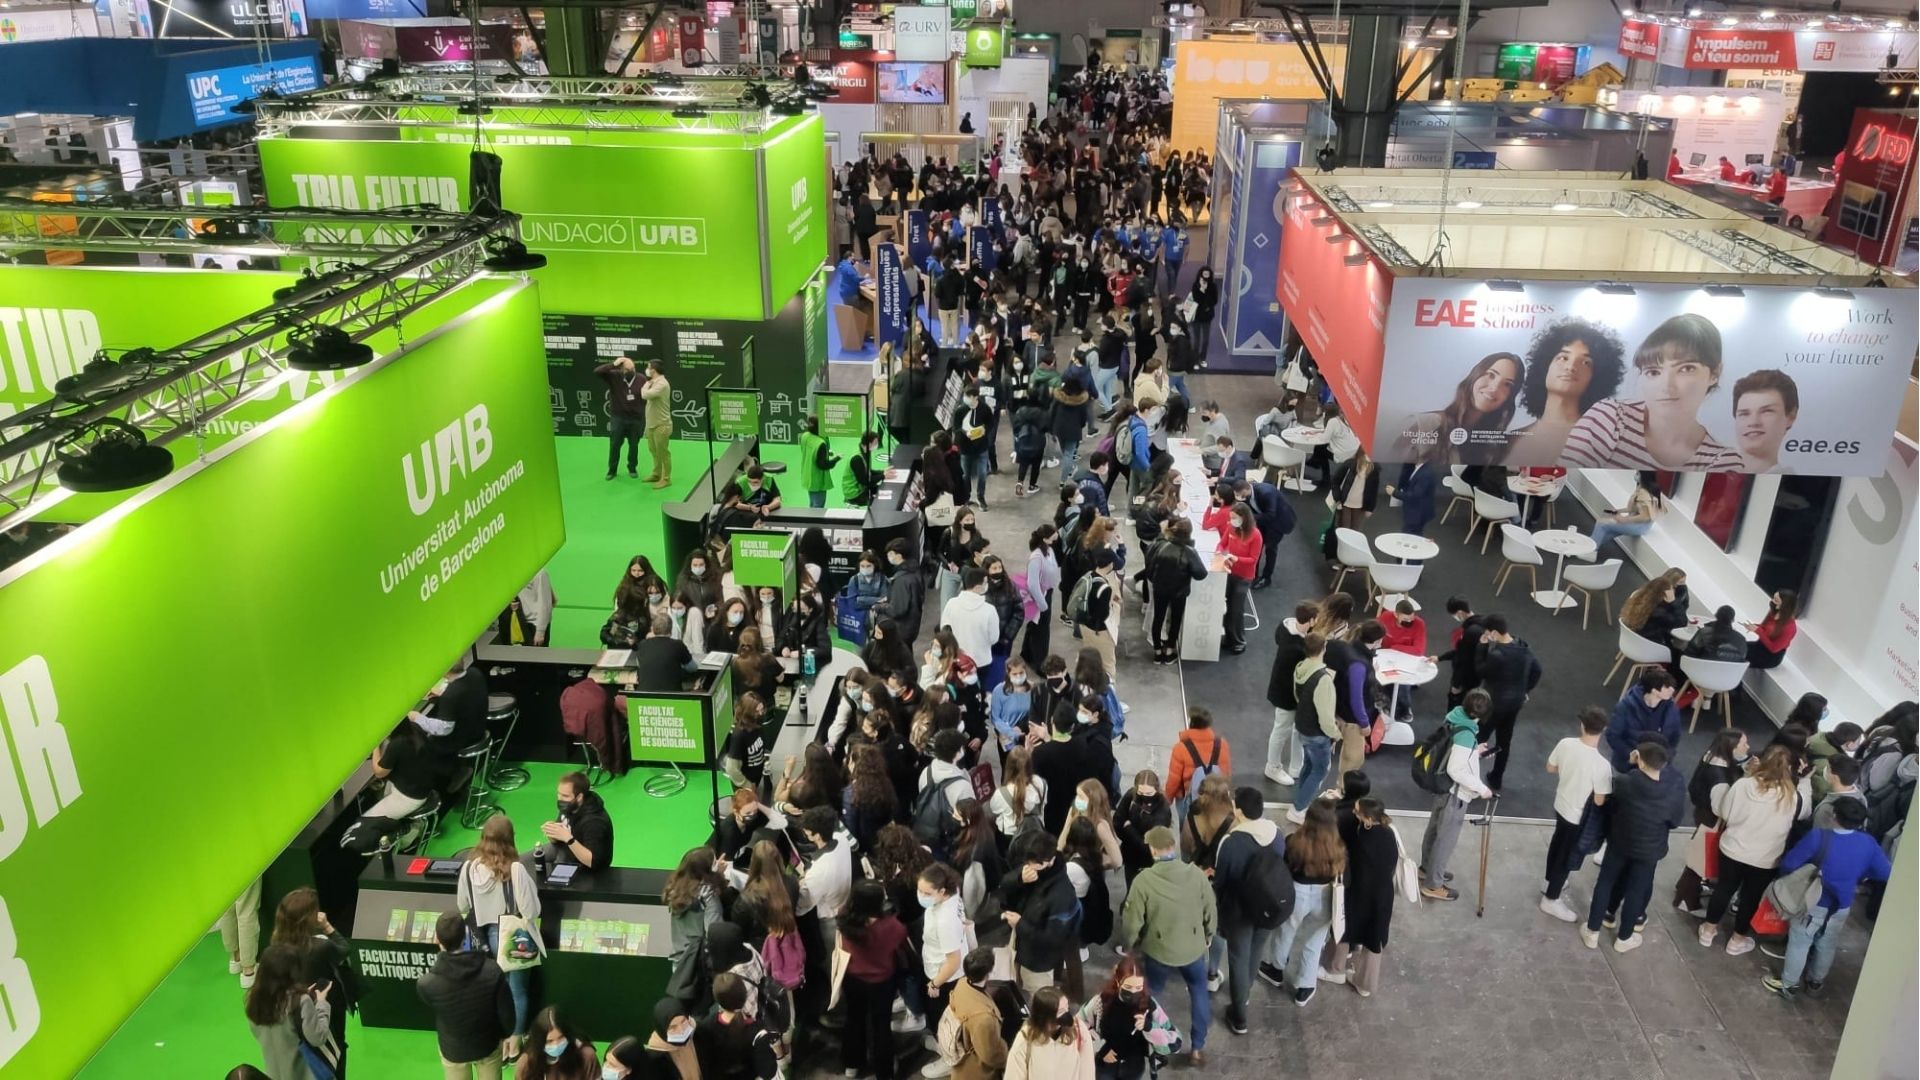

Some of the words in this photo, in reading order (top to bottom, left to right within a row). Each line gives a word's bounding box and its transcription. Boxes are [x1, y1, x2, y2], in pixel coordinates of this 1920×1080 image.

[914, 20, 942, 32] URV
[1694, 35, 1768, 52] Impulsem
[1692, 50, 1705, 63] el
[1706, 50, 1732, 63] teu
[1732, 50, 1779, 64] somni
[1187, 49, 1270, 85] bau
[190, 74, 222, 99] UPC
[832, 78, 867, 88] VIRGILI
[291, 174, 361, 211] TRIA
[364, 175, 460, 214] FUTUR
[518, 219, 627, 246] UNDACIÓ
[639, 224, 699, 246] UAB
[912, 224, 920, 244] Dret
[1415, 298, 1478, 328] EAE
[1848, 308, 1896, 325] Work
[1482, 315, 1537, 330] School
[1806, 330, 1824, 344] to
[1828, 328, 1889, 347] change
[1783, 351, 1825, 367] your
[1829, 349, 1884, 366] future
[1402, 429, 1439, 438] titulació
[1411, 437, 1438, 445] oficial
[1784, 438, 1861, 455] eae.es
[402, 403, 494, 516] UAB
[380, 509, 463, 594] Universitat
[463, 459, 525, 525] Autònoma
[740, 540, 769, 549] FACULTAT
[420, 573, 440, 602] de
[439, 511, 506, 584] Barcelona
[638, 705, 675, 716] FACULTAT
[639, 716, 651, 727] DE
[650, 714, 684, 728] CIÈNCIES
[639, 725, 683, 739] POLÍTIQUES
[640, 736, 652, 747] DE
[651, 737, 697, 749] SOCIOLOGIA
[747, 736, 764, 755] UAB
[358, 948, 410, 965] FACULTAT
[410, 951, 426, 966] DE
[361, 961, 424, 981] POLÍTIQUES
